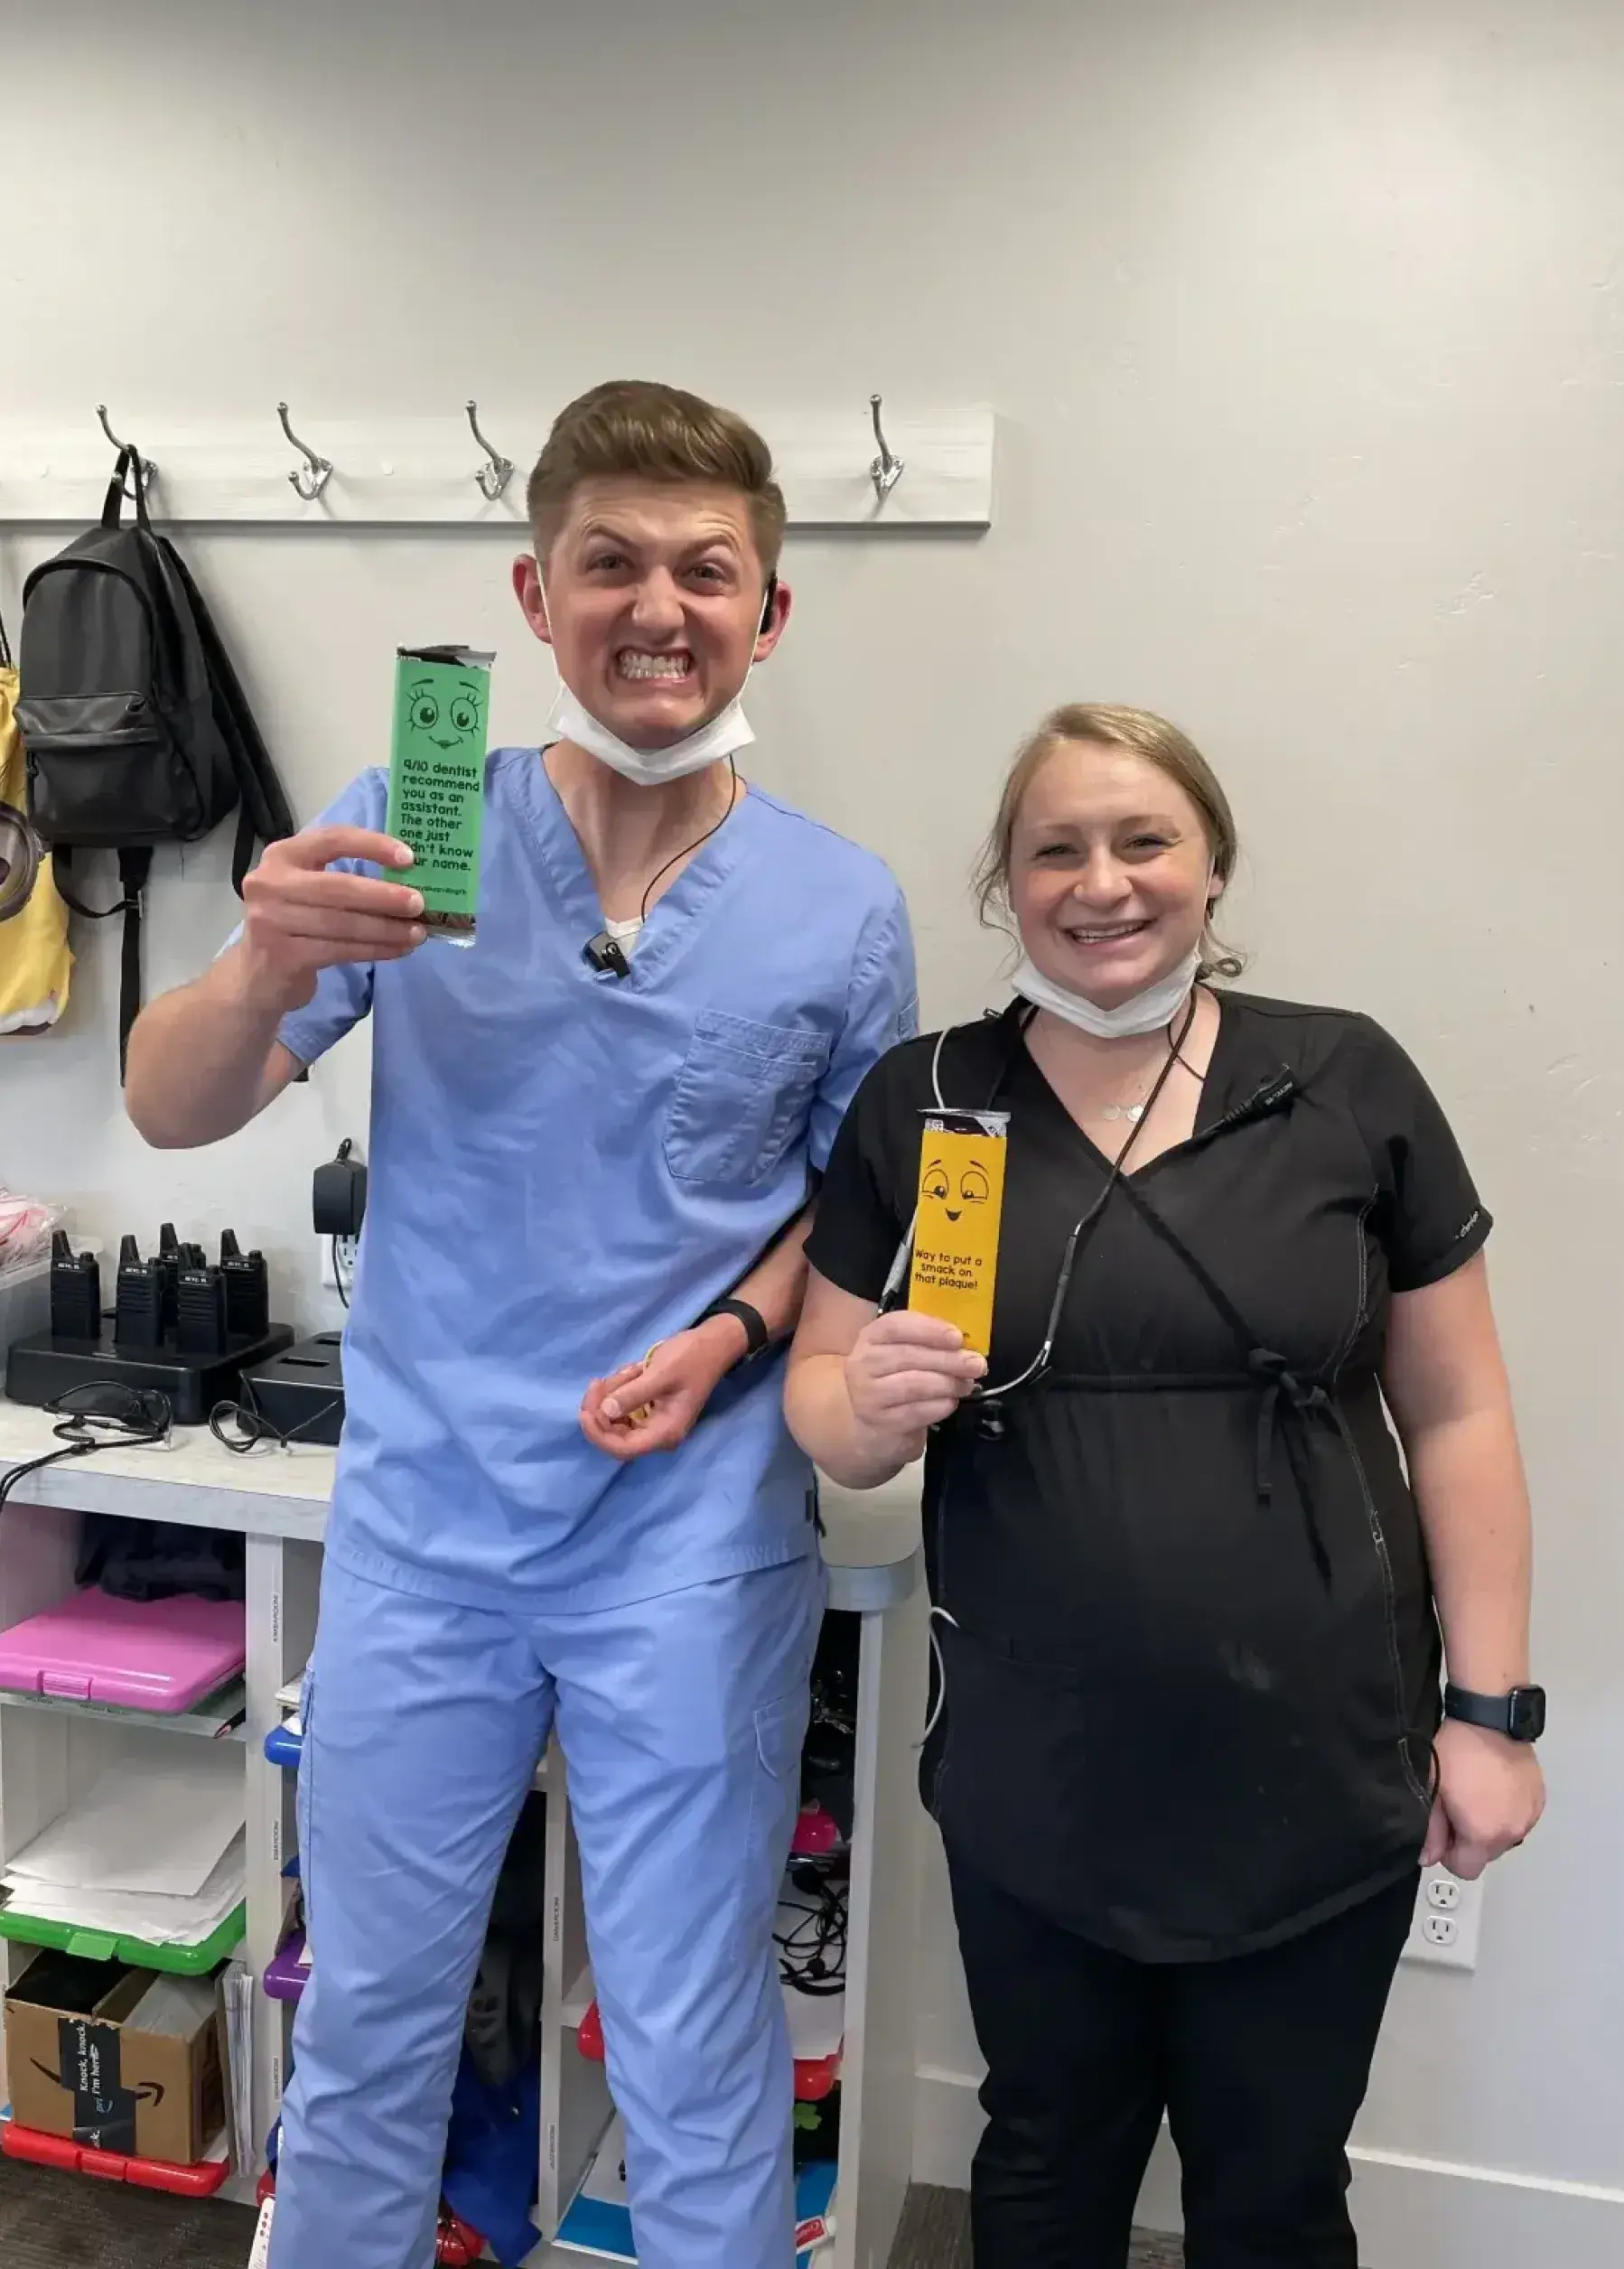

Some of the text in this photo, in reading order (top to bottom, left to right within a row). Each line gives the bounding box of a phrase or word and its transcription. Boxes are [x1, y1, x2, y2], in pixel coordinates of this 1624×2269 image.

[403, 759, 477, 778] 9/10 dentist
[402, 775, 480, 792] recommend
[403, 789, 464, 803] you as an
[400, 800, 462, 817] assistant.
[400, 813, 462, 830] The other
[399, 828, 450, 842] one just
[403, 840, 473, 858] dn't know
[433, 858, 471, 872] name.
[915, 1249, 983, 1266] Way to put a
[921, 1263, 972, 1277] smack on
[914, 1271, 978, 1290] that plaque!
[76, 2023, 89, 2092] Knock, knock.
